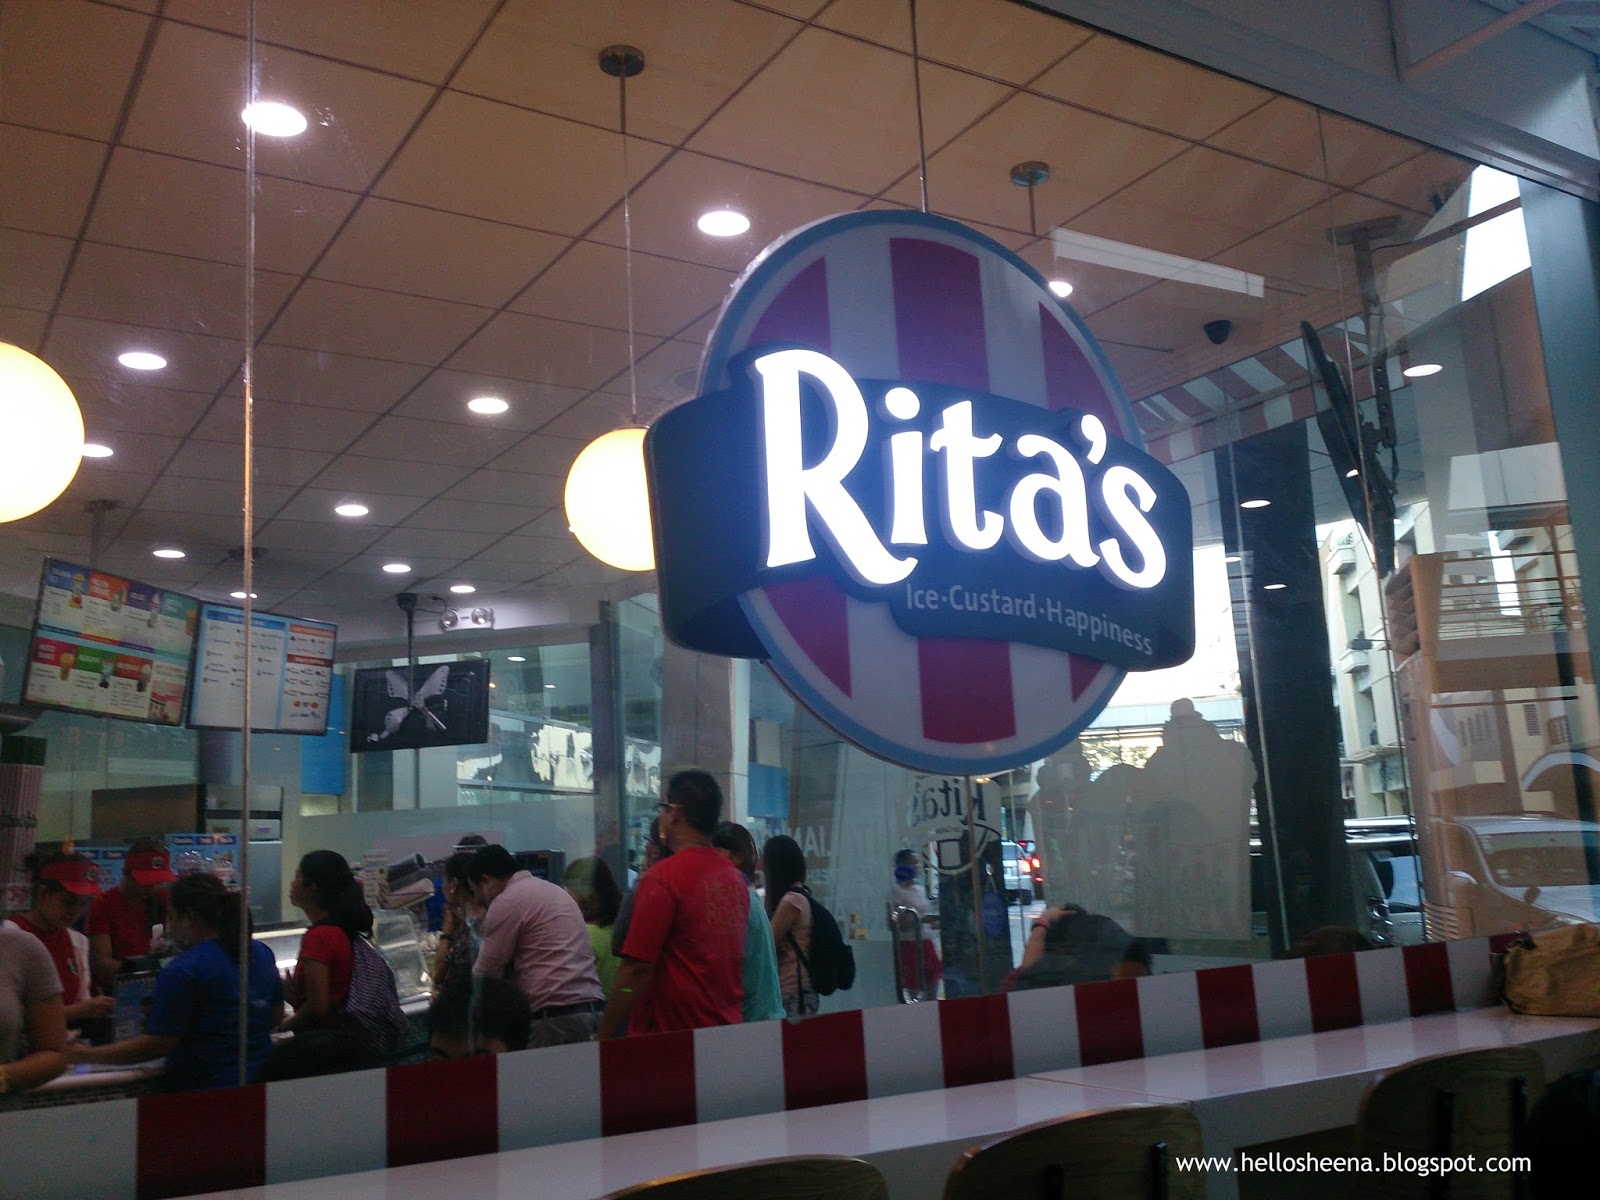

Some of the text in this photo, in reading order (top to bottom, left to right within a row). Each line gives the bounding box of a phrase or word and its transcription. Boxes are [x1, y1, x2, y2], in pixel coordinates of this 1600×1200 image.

[754, 349, 1167, 589] Rita's
[949, 585, 1037, 619] Custard
[1046, 598, 1153, 656] Happiness
